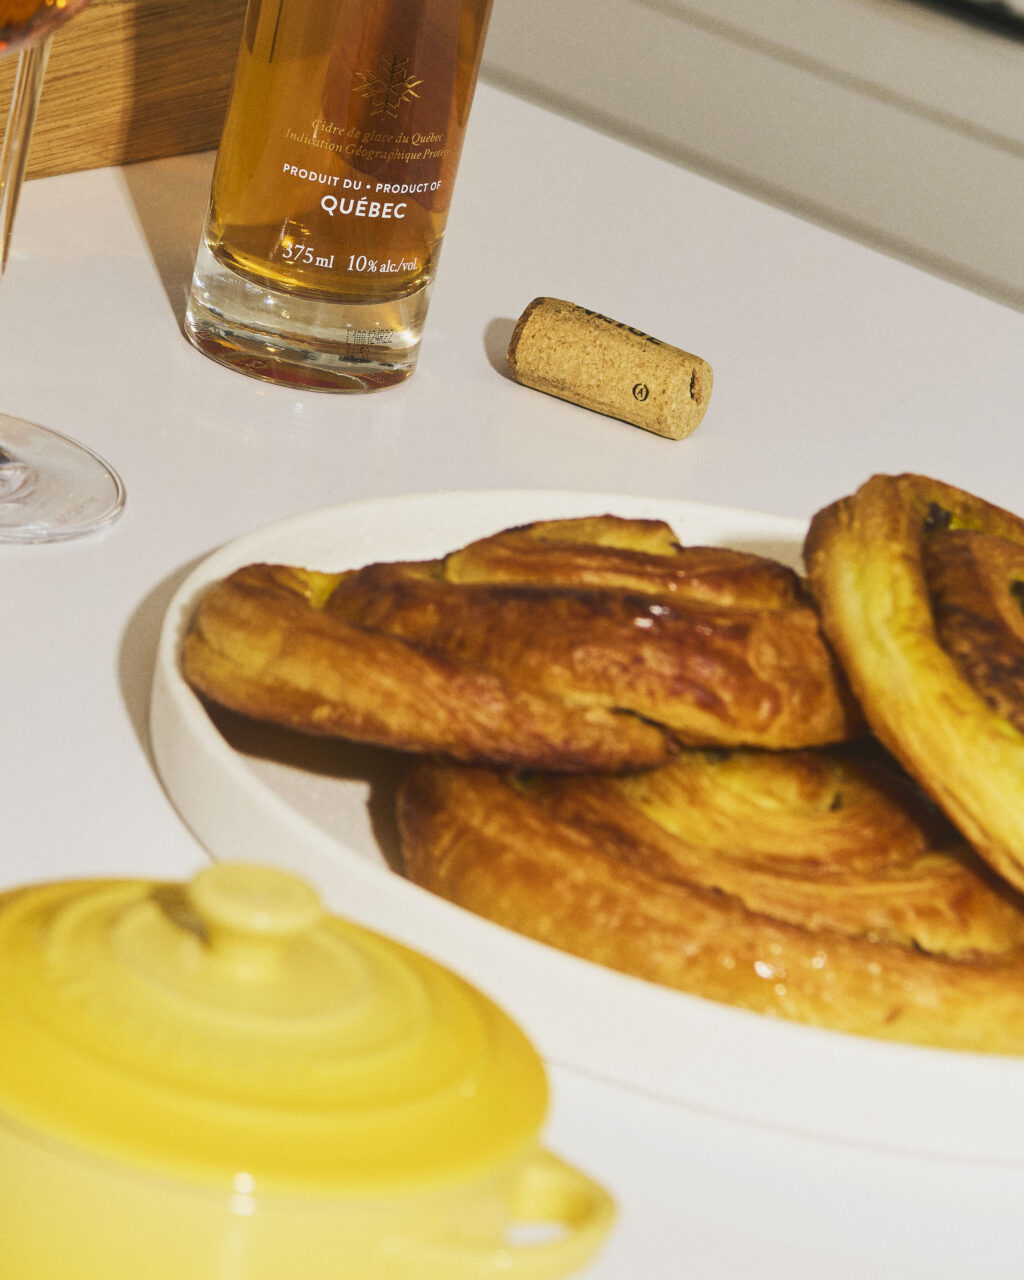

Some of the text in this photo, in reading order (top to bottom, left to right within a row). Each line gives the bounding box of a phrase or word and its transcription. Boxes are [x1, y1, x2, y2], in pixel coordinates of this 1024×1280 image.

[311, 119, 345, 136] Cidre
[347, 126, 361, 139] de
[362, 129, 394, 144] glace
[396, 131, 409, 143] du
[285, 128, 343, 153] Indication
[345, 143, 422, 163] Géographique
[282, 163, 443, 194] PRODUIT DU PRODUCT OF
[320, 195, 408, 220] QUÉBEC
[347, 254, 378, 273] 10%
